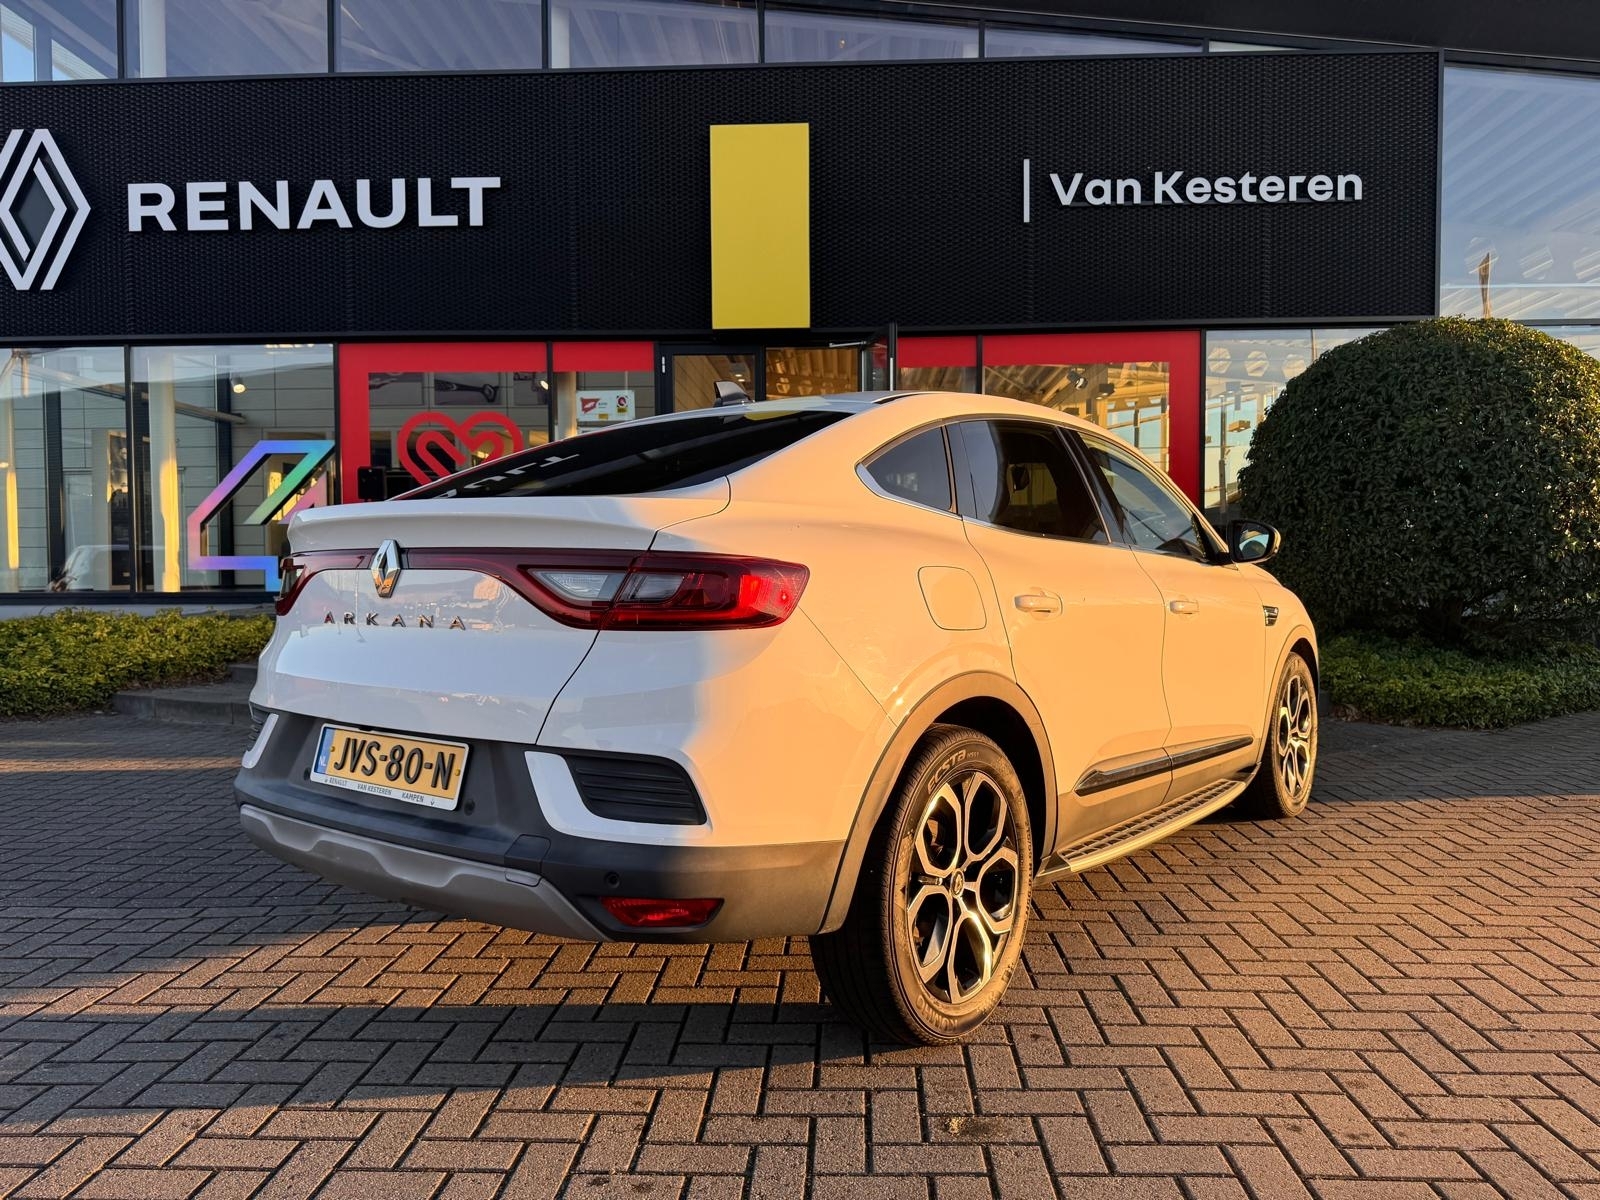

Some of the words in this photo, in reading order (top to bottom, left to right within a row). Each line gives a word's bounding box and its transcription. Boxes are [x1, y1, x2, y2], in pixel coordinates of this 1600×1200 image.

[128, 177, 501, 232] RENAULT
[1050, 172, 1142, 205] Van
[1154, 171, 1363, 204] Kesteren
[324, 611, 466, 631] ARKANA
[334, 737, 456, 790] JVS-80-N
[329, 777, 348, 787] RENAULT
[357, 783, 367, 792] VAN
[367, 785, 392, 797] KESTEREN
[401, 791, 425, 804] KAMPEN
[915, 994, 958, 1032] KUMHO
